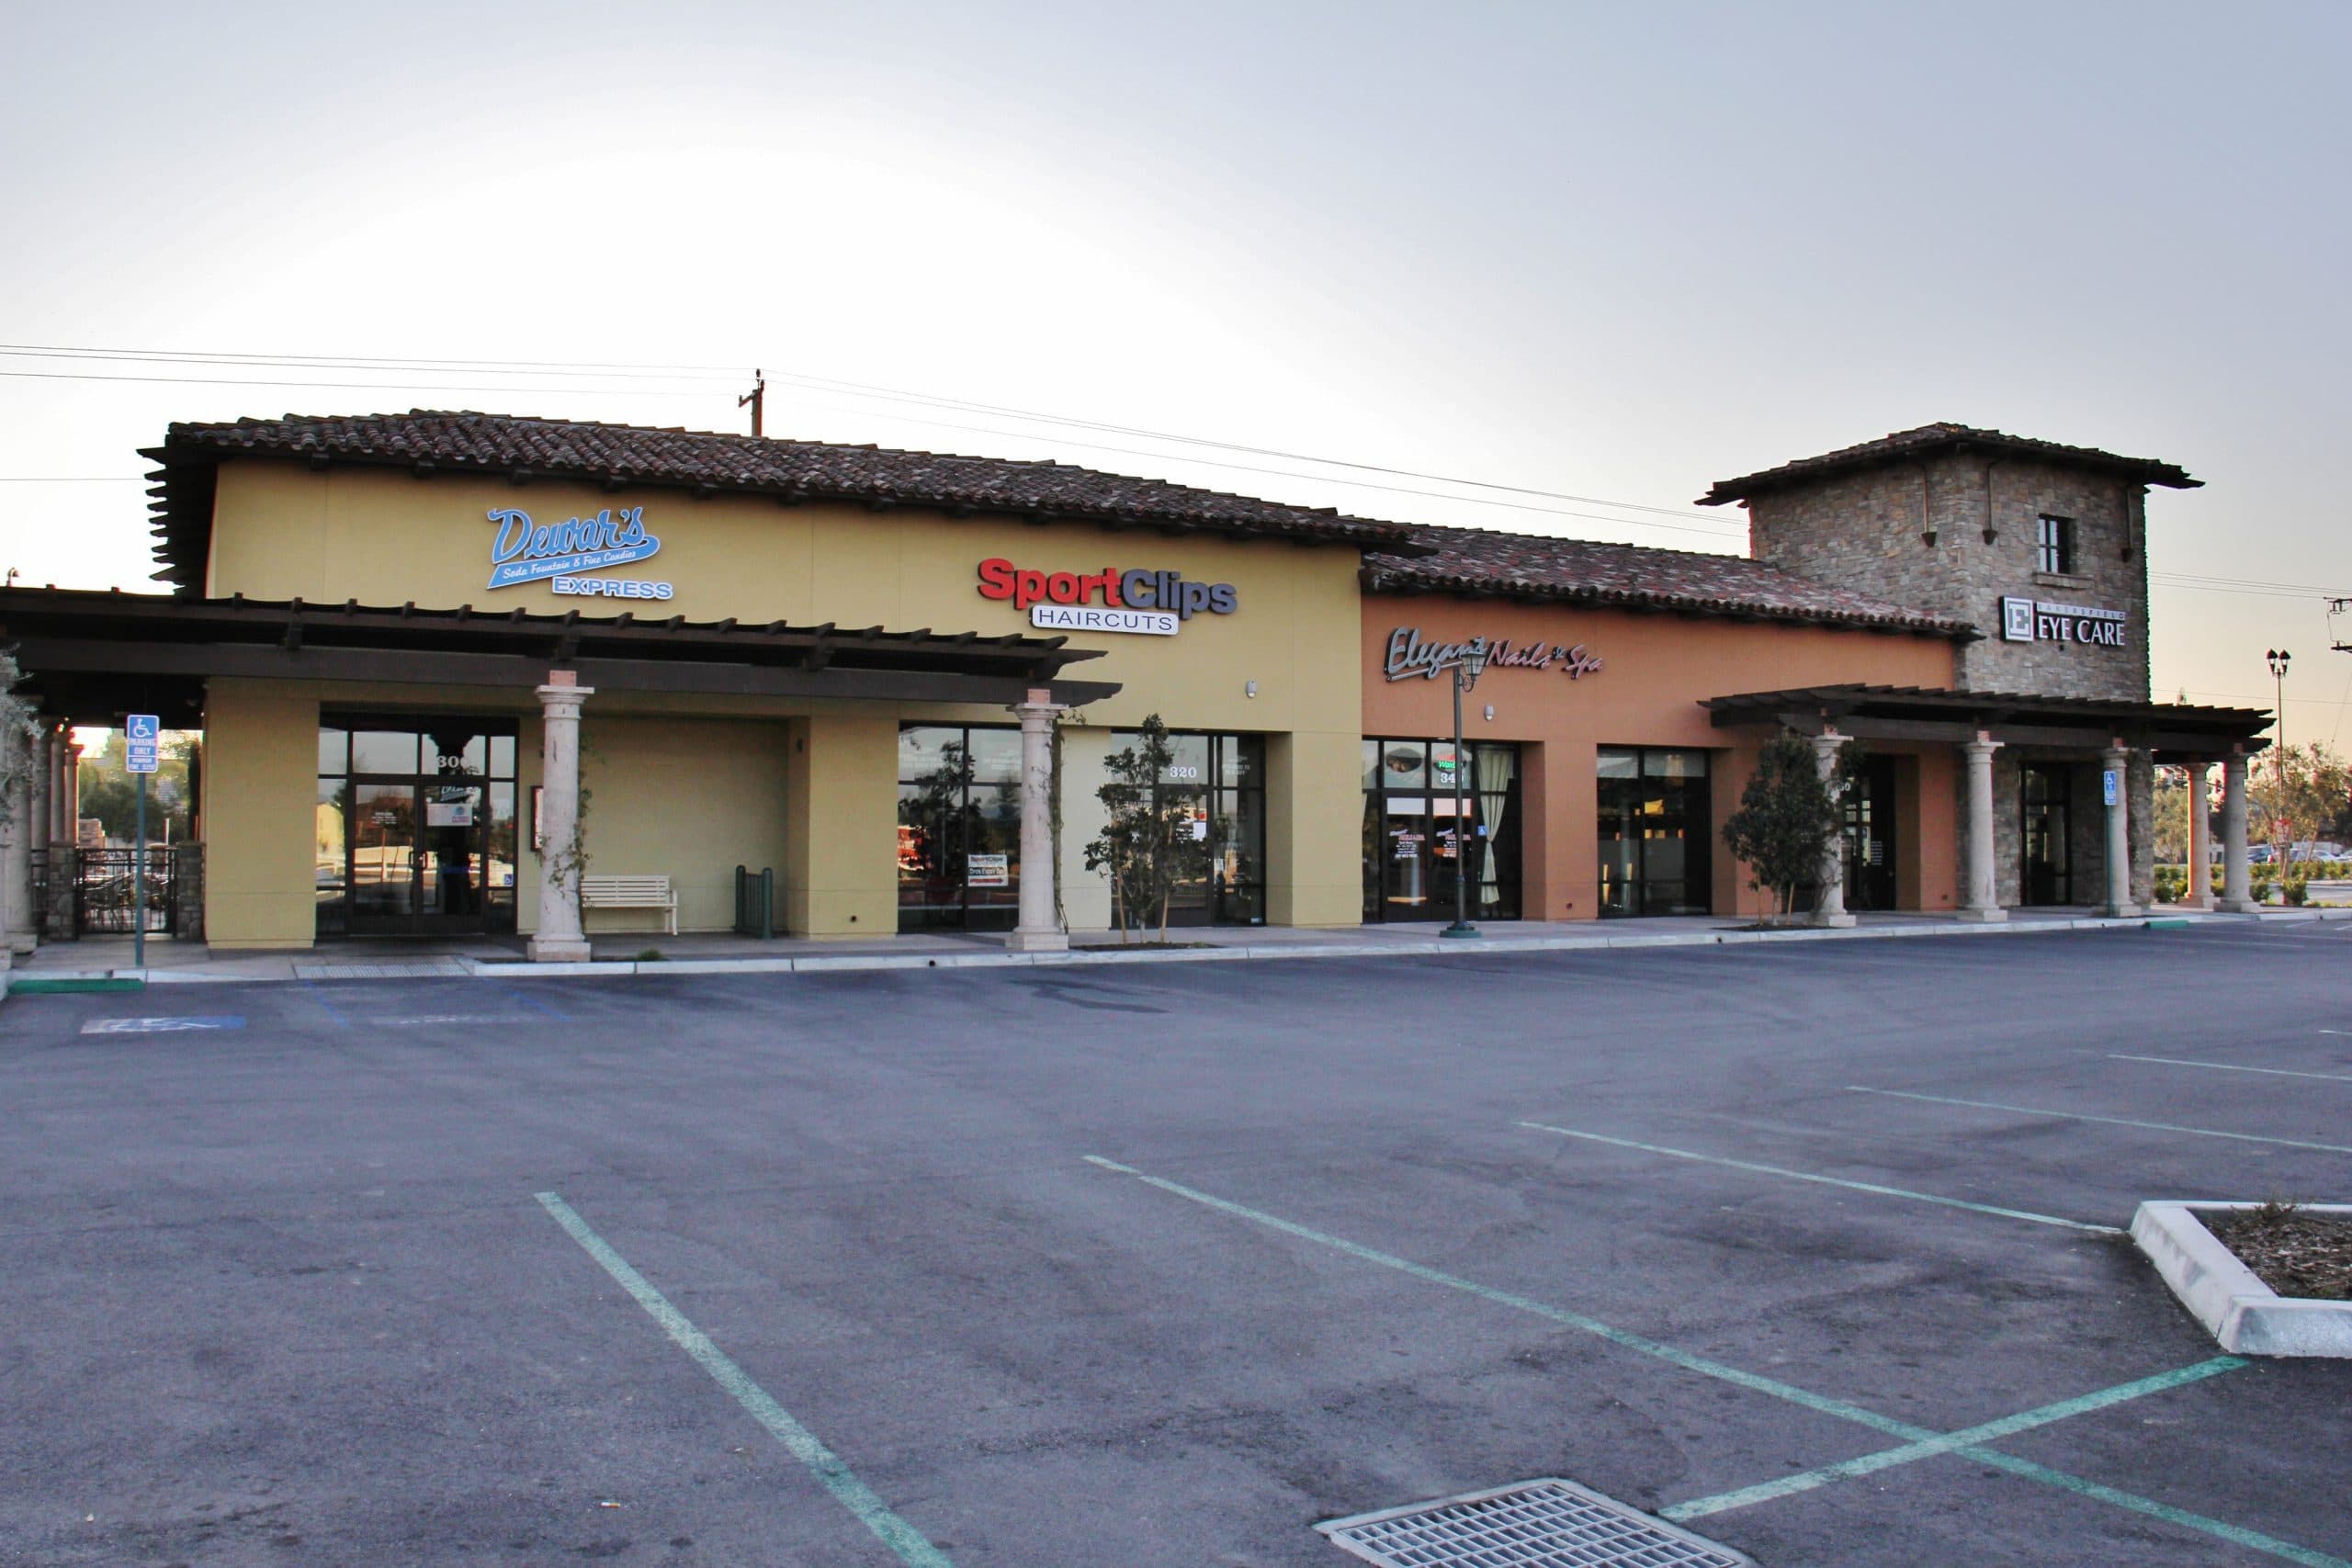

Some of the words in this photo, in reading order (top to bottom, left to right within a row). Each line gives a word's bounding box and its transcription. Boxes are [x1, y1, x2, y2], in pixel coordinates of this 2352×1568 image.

[487, 507, 648, 564] Dewar's
[503, 567, 528, 580] Soda
[531, 559, 571, 575] Fountain
[573, 557, 581, 568] &
[583, 555, 602, 567] Fine
[604, 550, 638, 563] Candies
[552, 576, 673, 600] EXPRESS
[1038, 609, 1173, 631] HAIRCUTS
[2038, 615, 2072, 641] EYE
[2076, 619, 2125, 646] CARE
[1486, 639, 1553, 670] Nails
[1564, 644, 1603, 680] Spa
[1170, 766, 1198, 778] 320
[1440, 772, 1464, 784] 34
